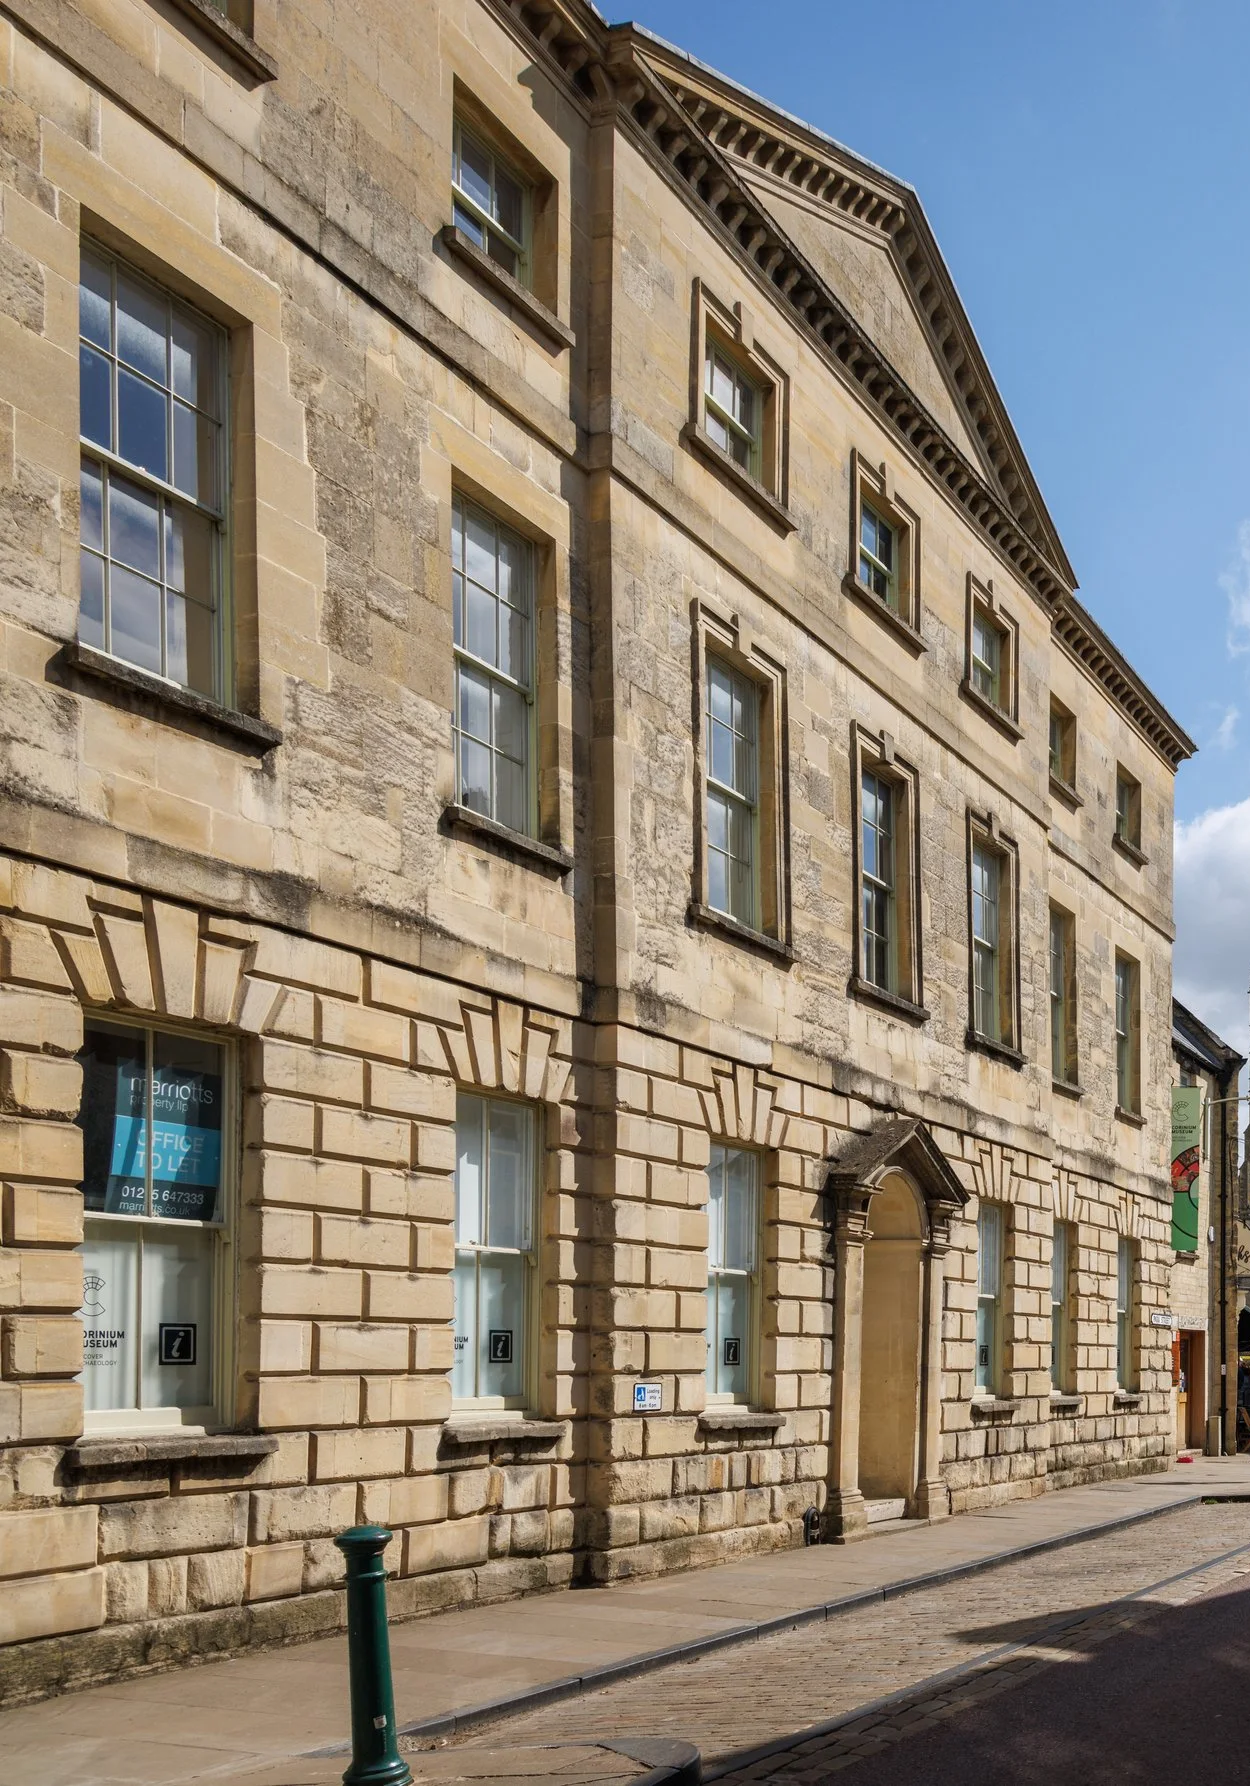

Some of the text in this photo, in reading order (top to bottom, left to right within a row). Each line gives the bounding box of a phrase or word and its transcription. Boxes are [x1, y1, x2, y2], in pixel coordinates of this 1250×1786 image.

[130, 1077, 213, 1104] marriotts
[130, 1095, 189, 1113] proerty llp
[137, 1129, 205, 1153] OFFICE
[136, 1151, 200, 1174] TO LET
[121, 1186, 204, 1204] 0125 647333
[83, 1330, 125, 1339] ORINIUM
[83, 1340, 118, 1348] USEUM
